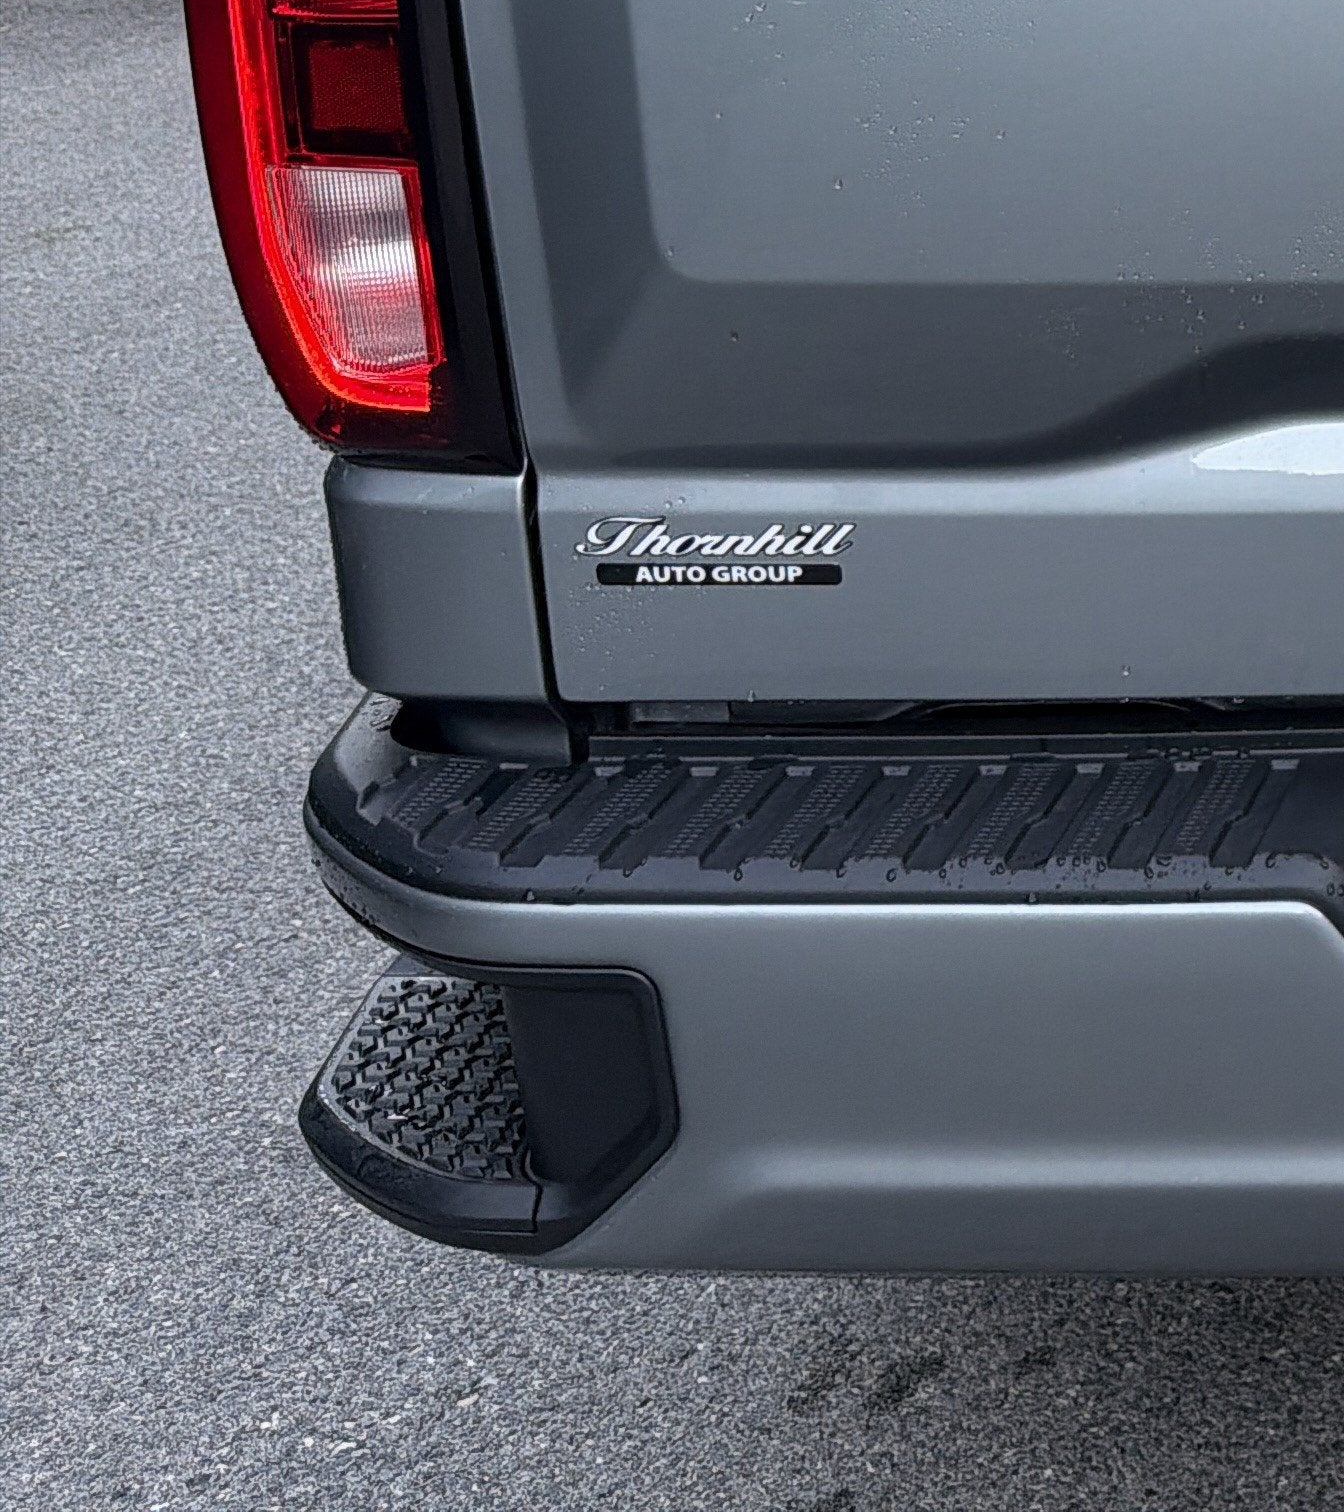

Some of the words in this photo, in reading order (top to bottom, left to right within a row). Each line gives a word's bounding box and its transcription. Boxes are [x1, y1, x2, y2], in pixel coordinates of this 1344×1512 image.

[575, 515, 856, 558] Thornhill
[634, 565, 706, 584] AUTO
[710, 565, 803, 584] GROUP
